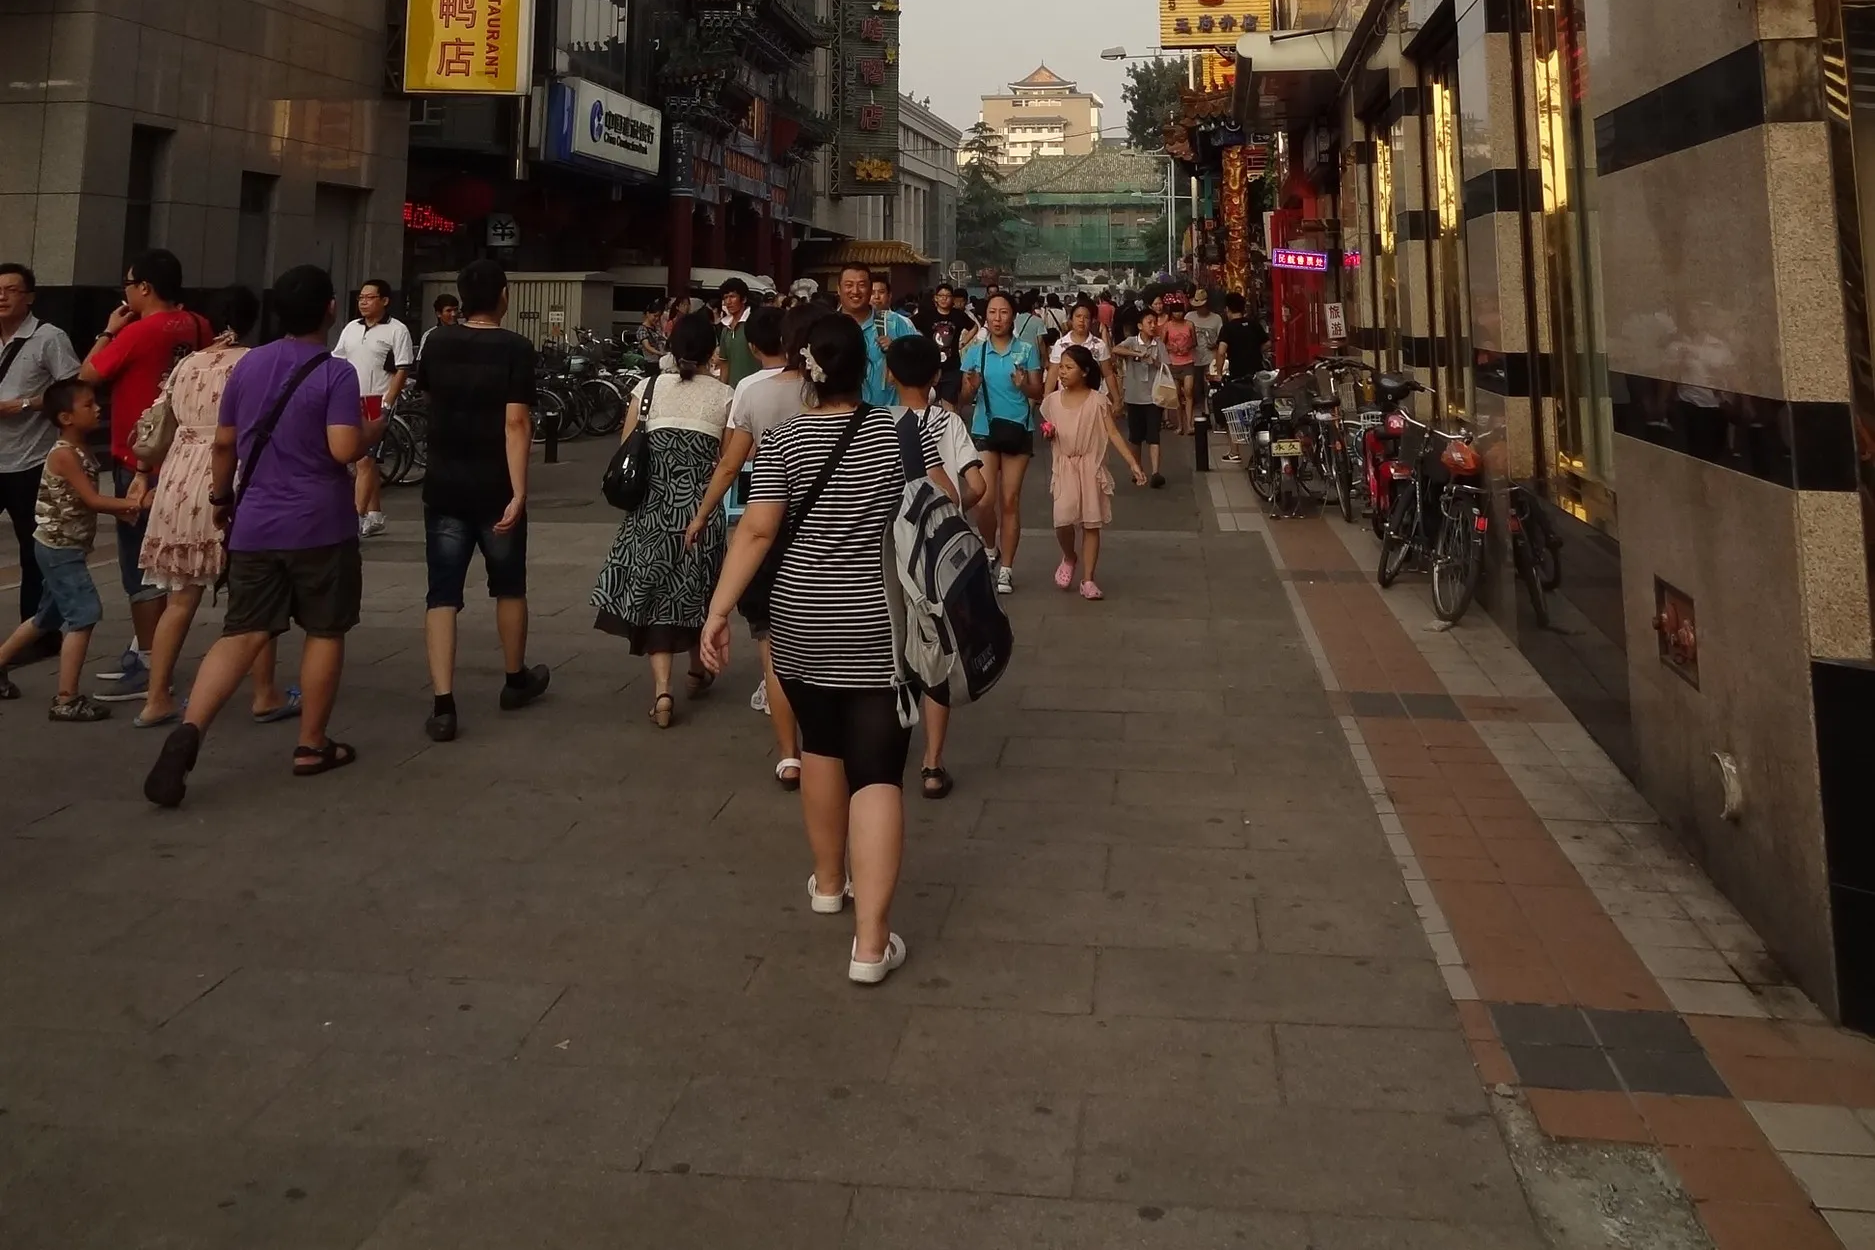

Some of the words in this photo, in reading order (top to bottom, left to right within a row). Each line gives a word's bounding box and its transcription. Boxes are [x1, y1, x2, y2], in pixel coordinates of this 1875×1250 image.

[605, 111, 654, 144] 中国建设银行
[1328, 304, 1343, 337] 旅游
[1274, 442, 1298, 452] 永久
